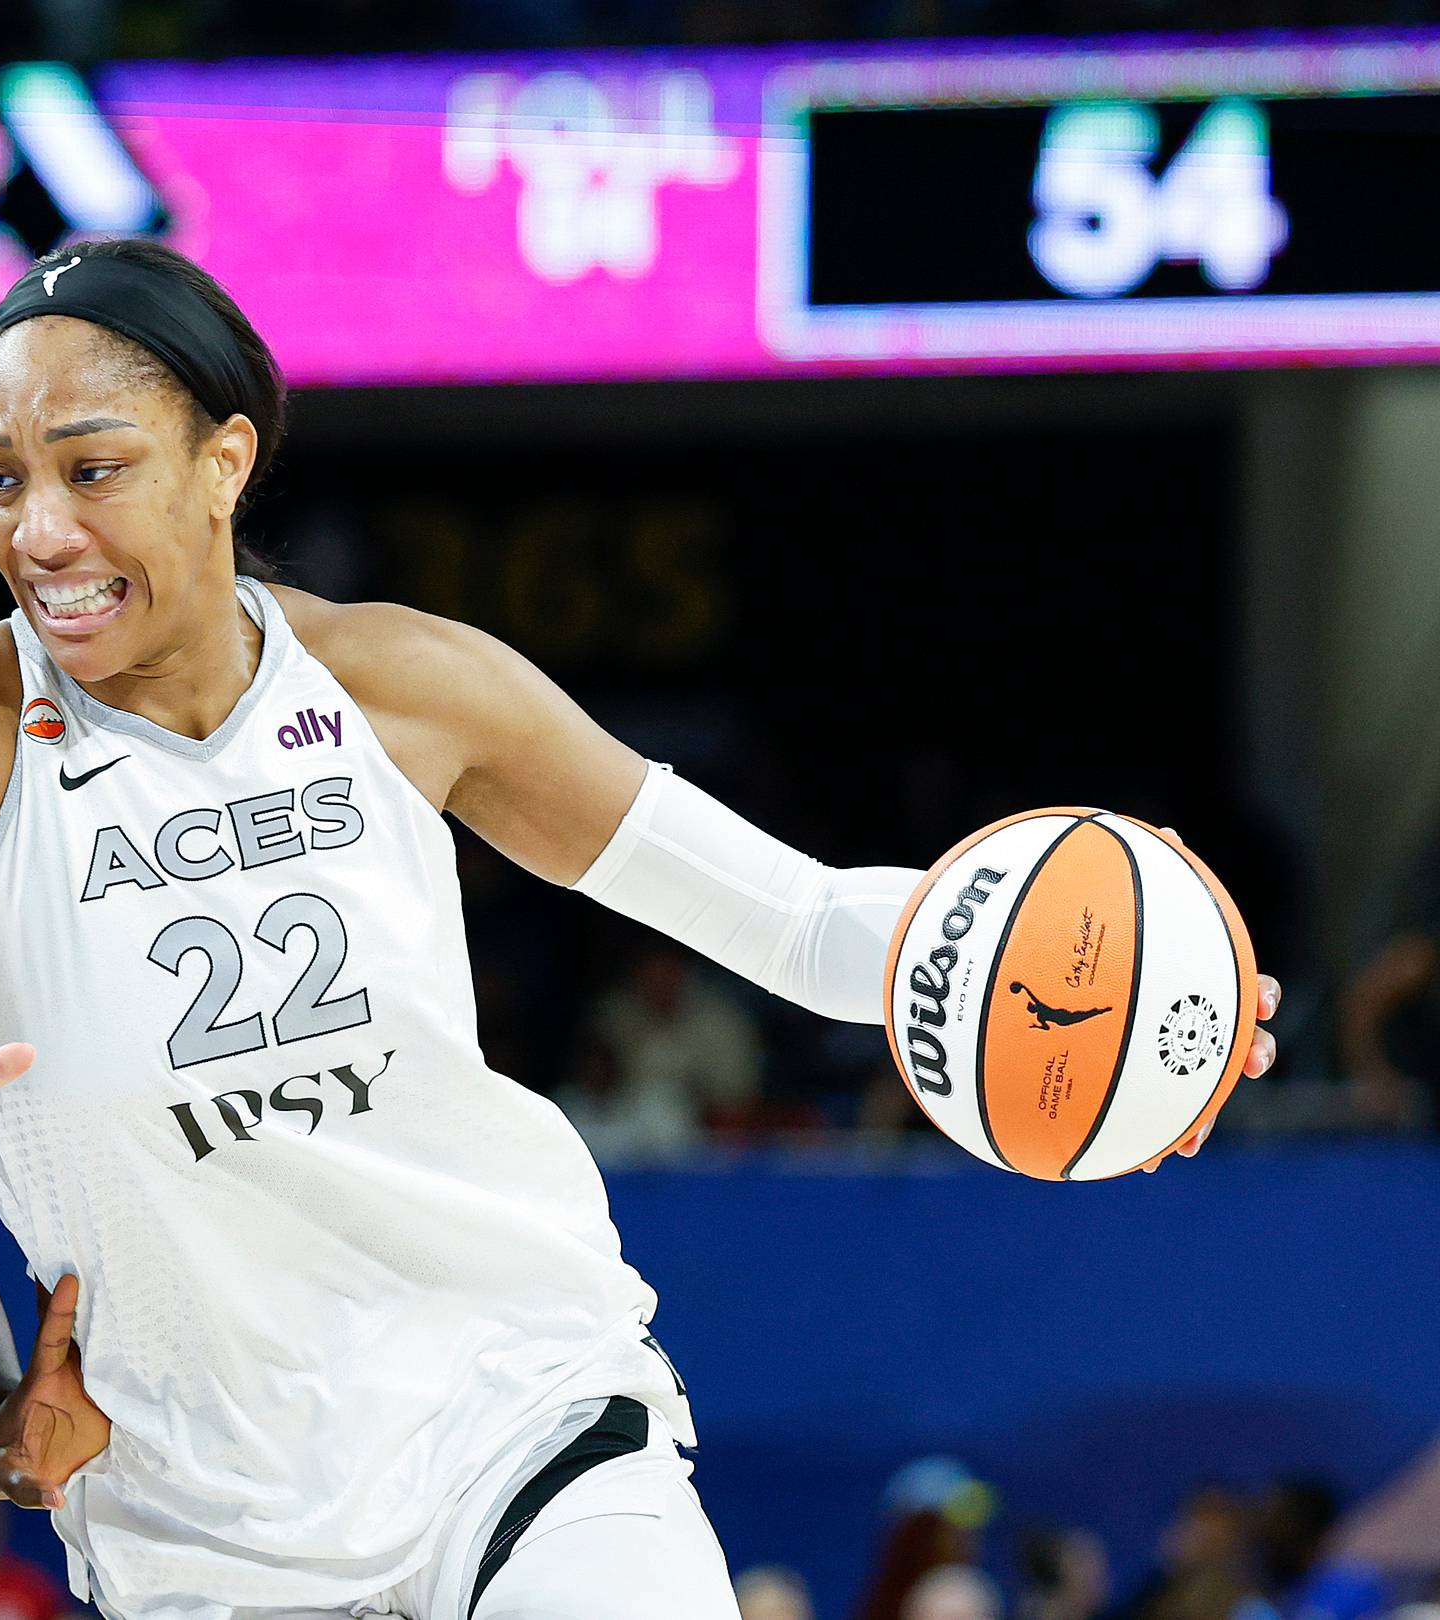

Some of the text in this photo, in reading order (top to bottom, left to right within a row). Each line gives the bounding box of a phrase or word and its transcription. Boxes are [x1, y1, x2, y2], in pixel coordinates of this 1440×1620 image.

[1027, 97, 1291, 297] 54
[278, 708, 342, 750] ally
[80, 777, 364, 902] ACES
[147, 893, 371, 1069] 22
[907, 867, 1010, 1098] Wilson
[958, 958, 974, 1021] EVO NXT
[167, 1050, 396, 1162] IPSY
[1039, 1057, 1055, 1110] OFFICIAL
[1049, 1050, 1068, 1119] GAME BALL
